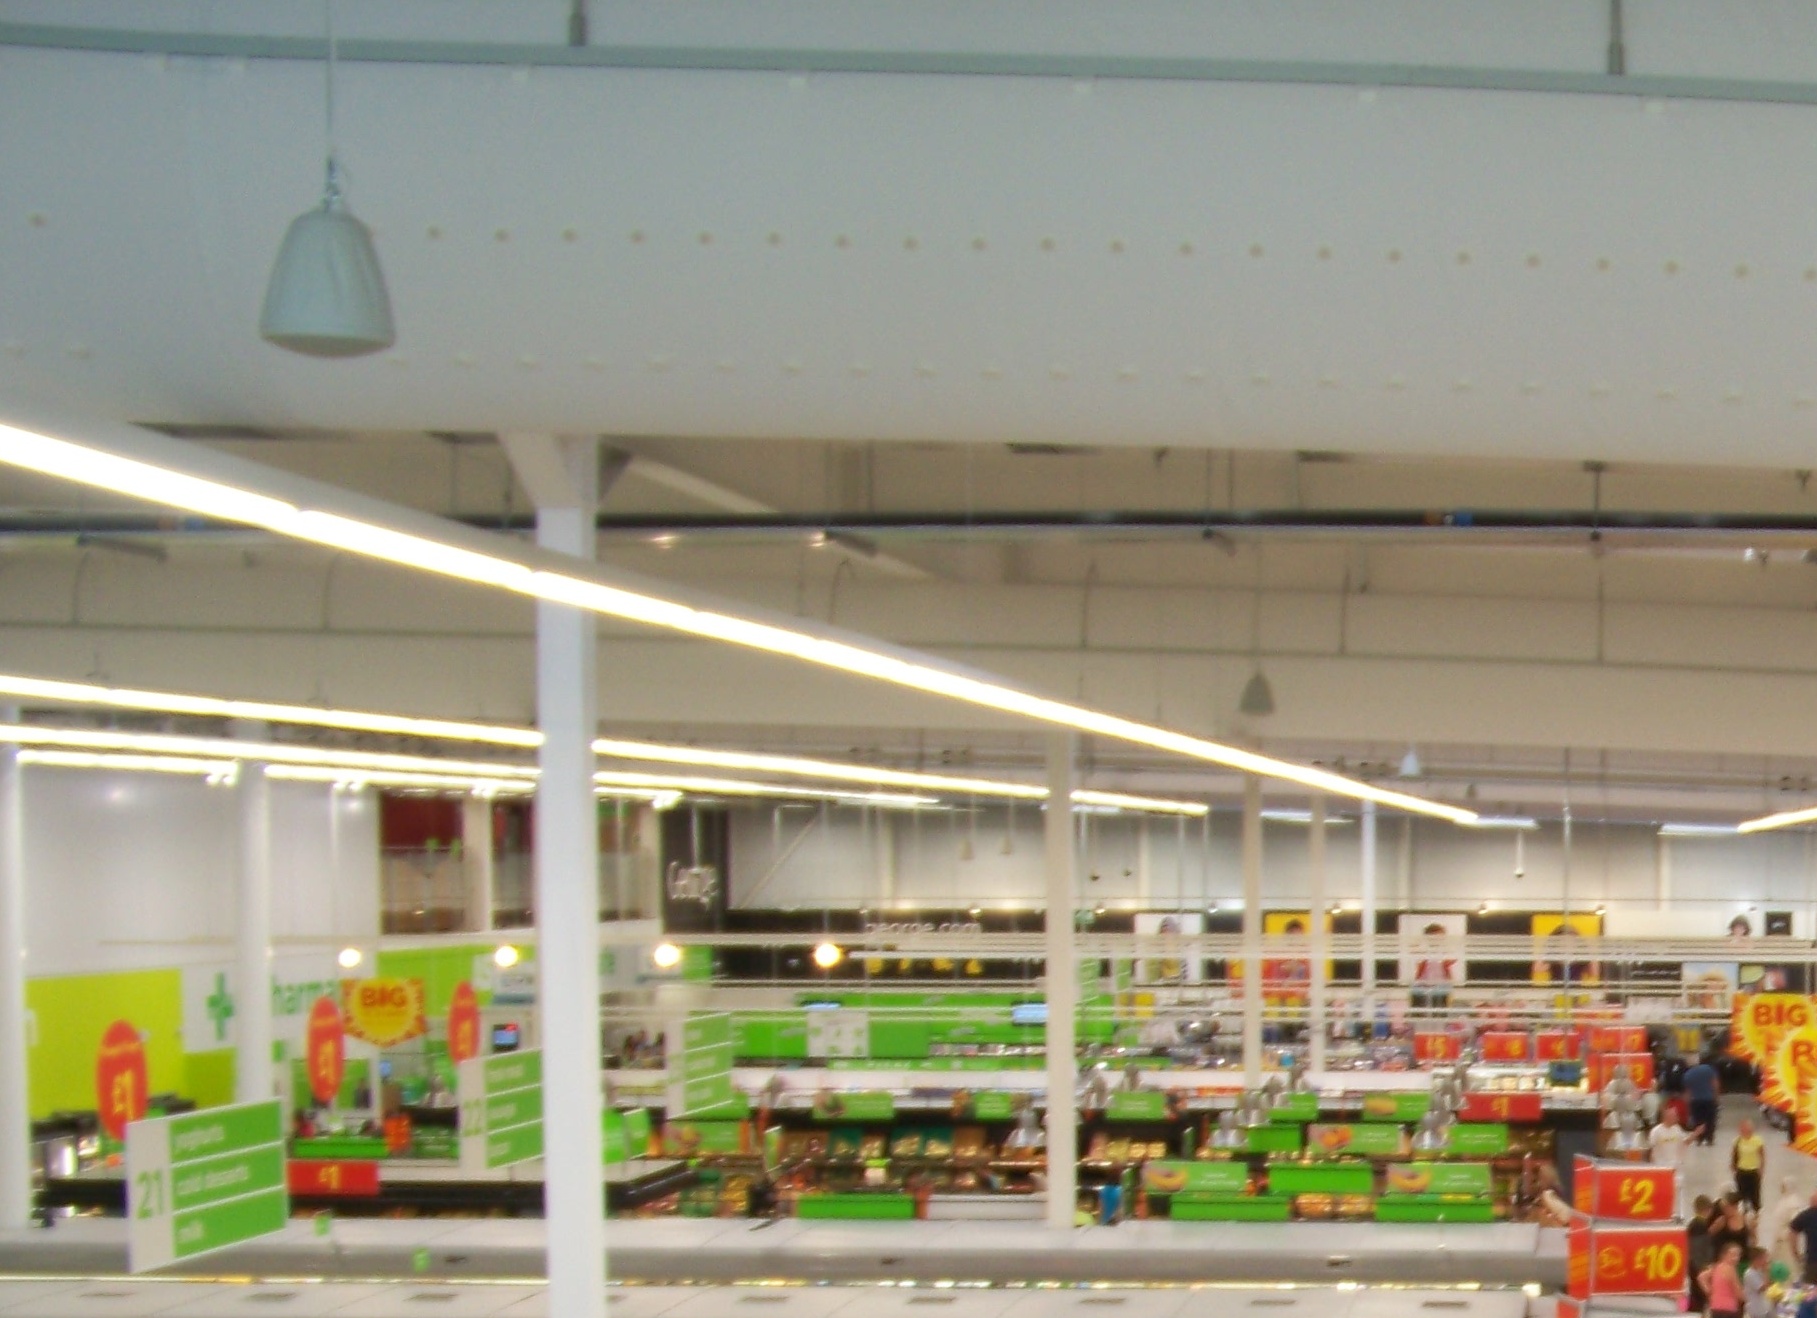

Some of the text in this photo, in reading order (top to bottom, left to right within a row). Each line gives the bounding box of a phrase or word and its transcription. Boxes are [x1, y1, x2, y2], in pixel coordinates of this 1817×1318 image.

[359, 985, 408, 1008] BIG
[1753, 1003, 1807, 1027] BIG
[135, 1170, 162, 1219] 21
[1619, 1178, 1655, 1214] £2
[1634, 1243, 1682, 1281] £10
